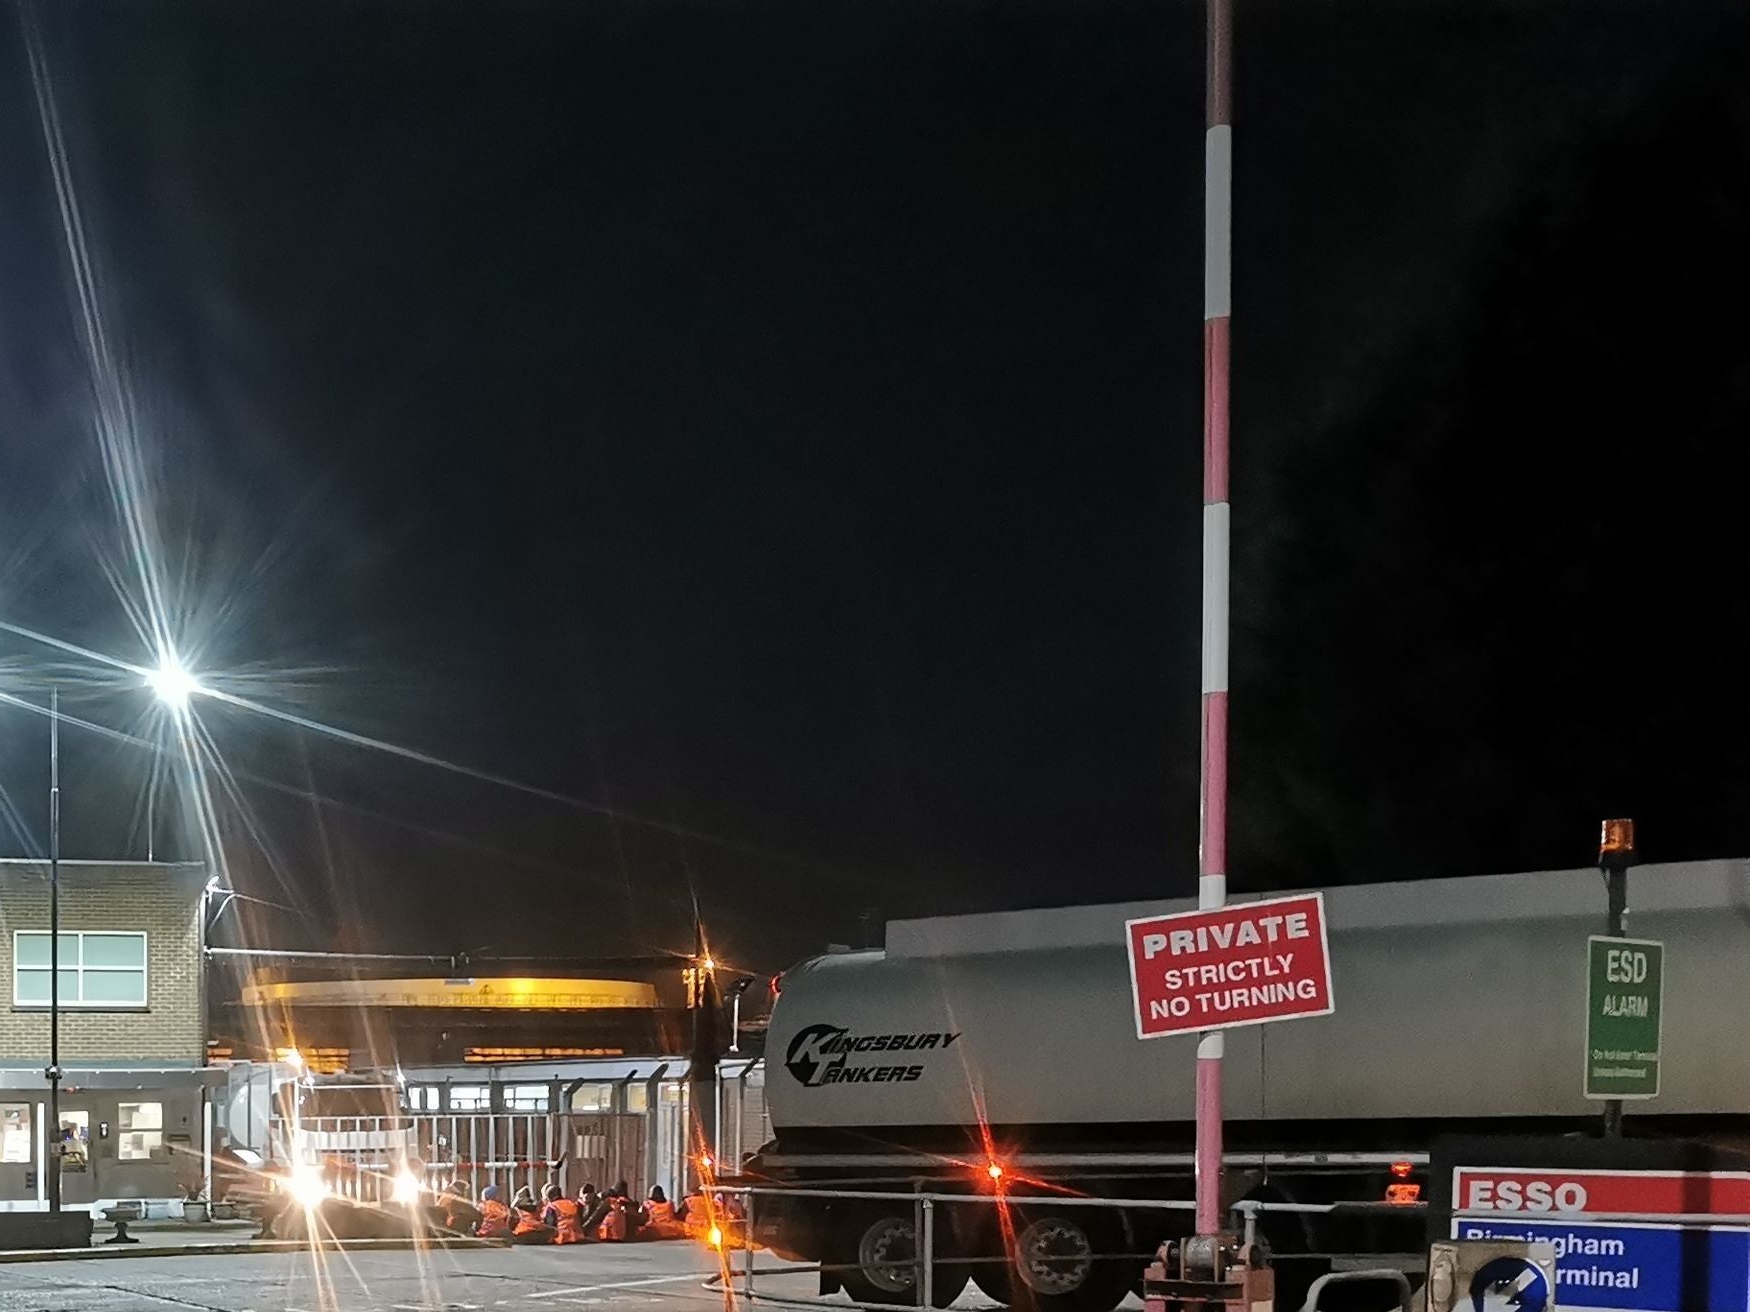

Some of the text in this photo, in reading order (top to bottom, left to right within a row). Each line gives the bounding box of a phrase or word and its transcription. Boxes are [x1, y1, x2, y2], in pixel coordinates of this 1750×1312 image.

[1143, 912, 1310, 959] PRIVATE
[1165, 953, 1294, 990] STRICTLY
[1606, 949, 1647, 983] ESD
[1150, 979, 1317, 1020] NO TURNING
[1602, 993, 1649, 1017] ALARM
[790, 1032, 962, 1064] KINGSBURY
[1469, 1180, 1587, 1212] ESSO
[1466, 1228, 1625, 1258] Biigham
[1556, 1267, 1639, 1289] rminal
